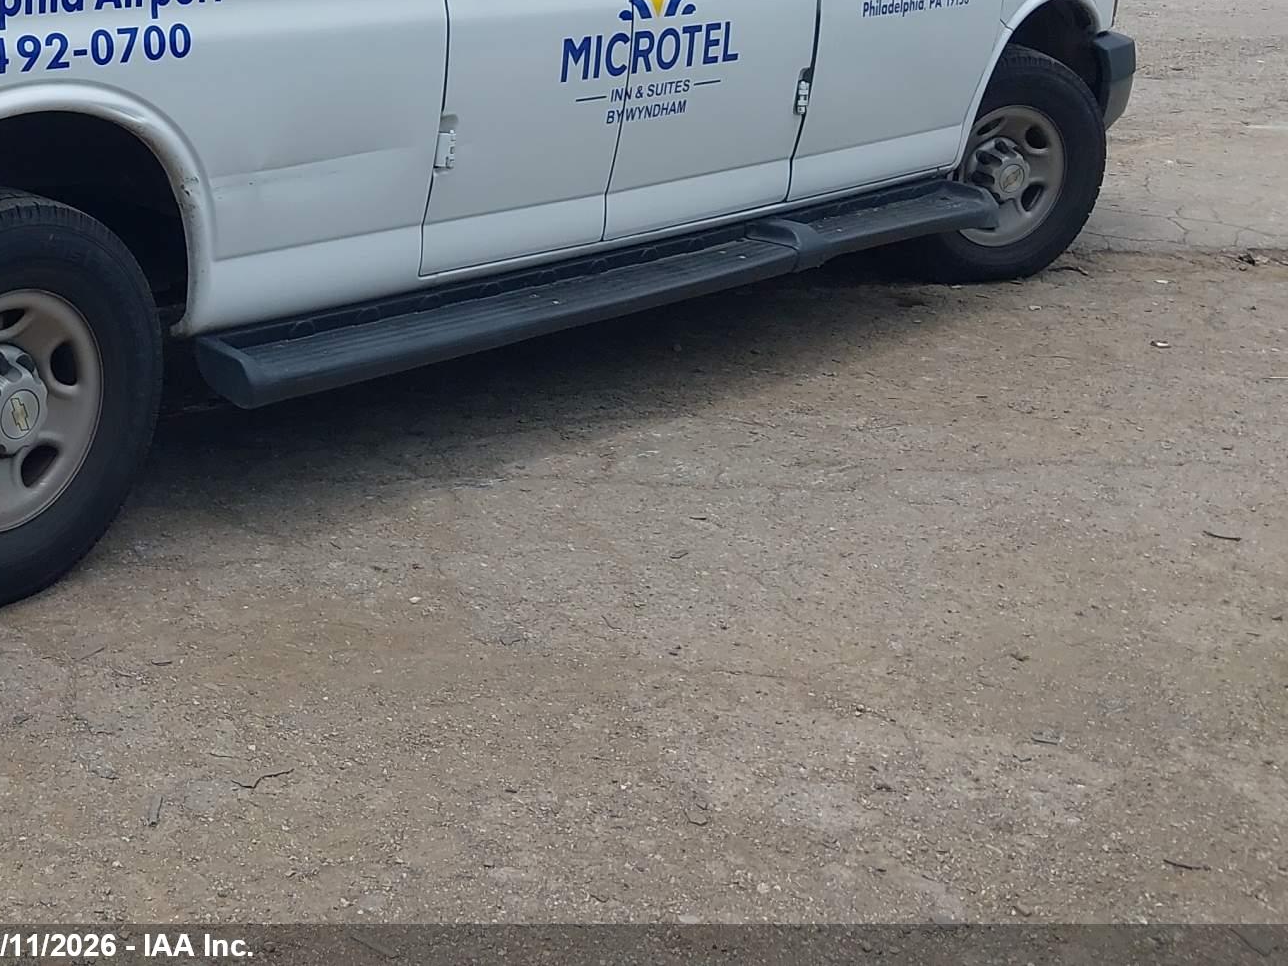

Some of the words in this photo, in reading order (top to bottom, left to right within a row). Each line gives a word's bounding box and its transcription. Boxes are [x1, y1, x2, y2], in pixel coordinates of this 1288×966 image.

[560, 21, 739, 83] MICROTEL
[610, 86, 633, 102] INN
[635, 85, 644, 99] &
[646, 79, 691, 97] SUITES
[606, 109, 624, 125] BY
[625, 99, 687, 122] WYNDHAM
